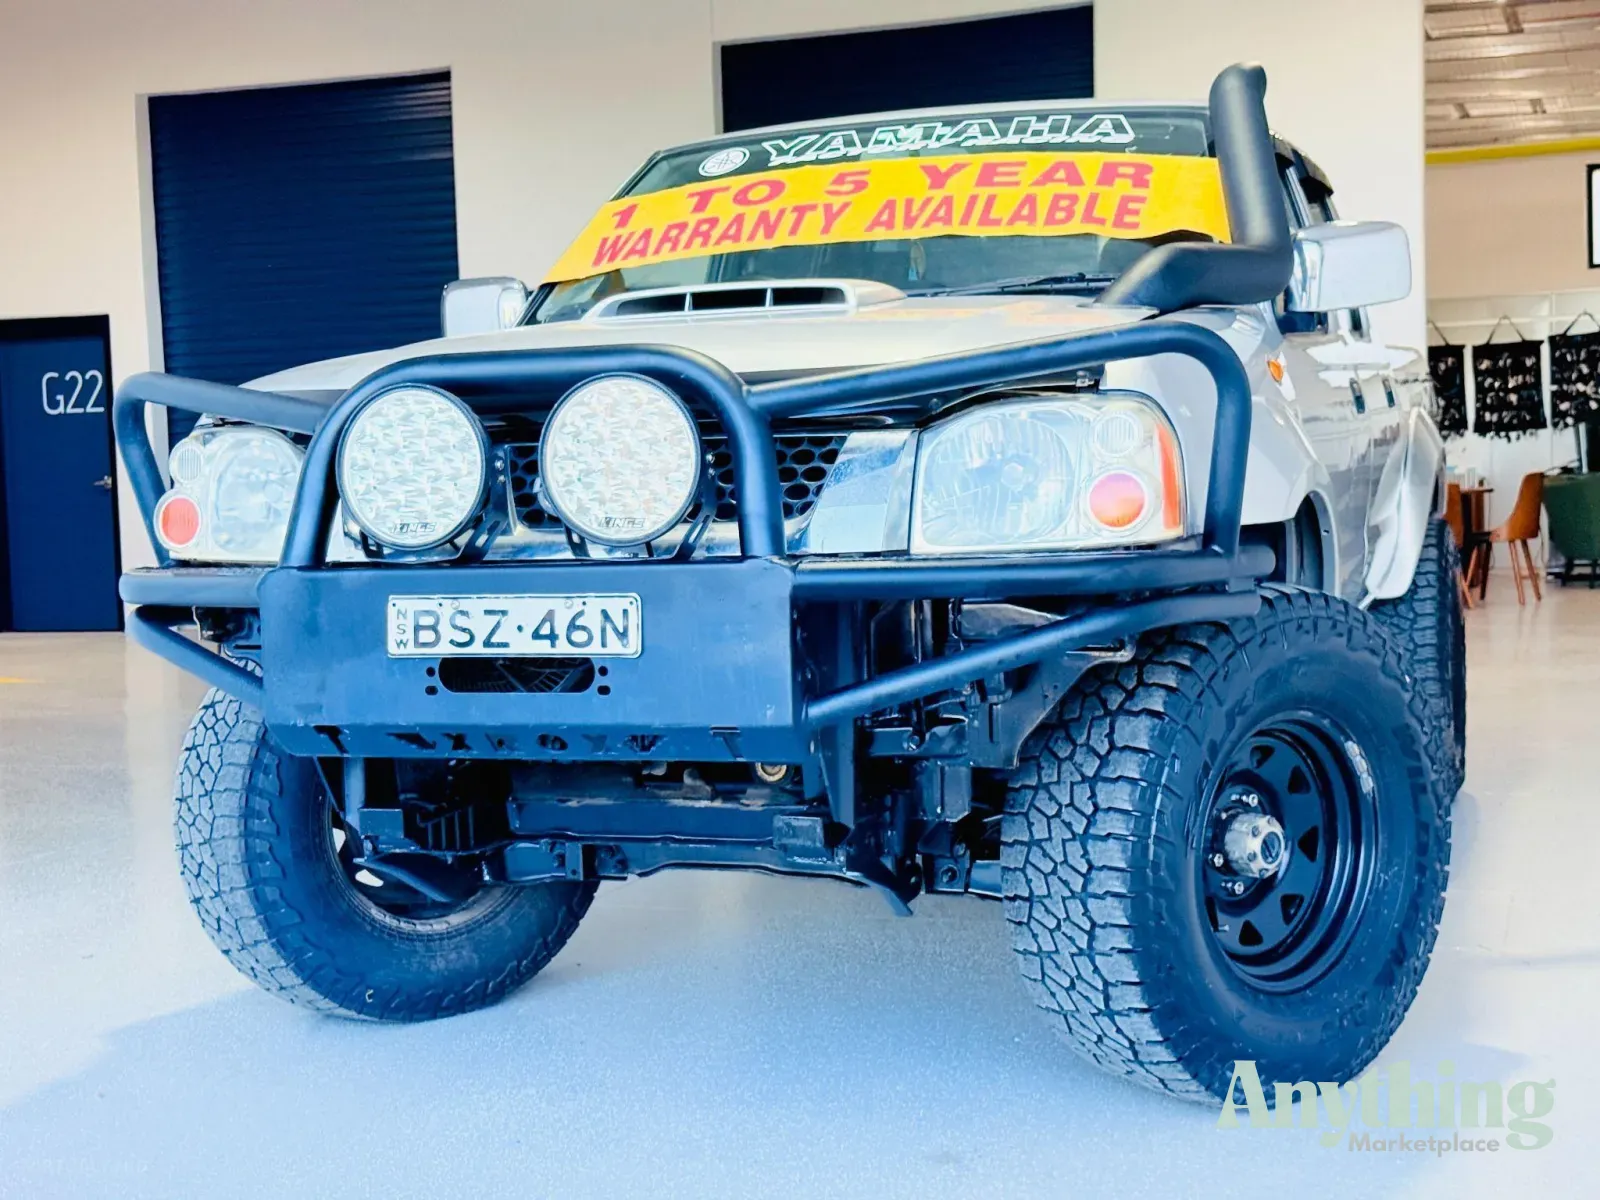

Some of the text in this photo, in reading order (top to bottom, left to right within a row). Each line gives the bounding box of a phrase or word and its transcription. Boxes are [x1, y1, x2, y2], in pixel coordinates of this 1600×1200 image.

[762, 114, 1136, 166] YAMAHA
[611, 160, 1154, 229] 1 TO 5 YEAR
[591, 192, 1149, 269] WARRANTY AVAILABLE
[41, 369, 105, 415] G22
[395, 608, 410, 650] NSW
